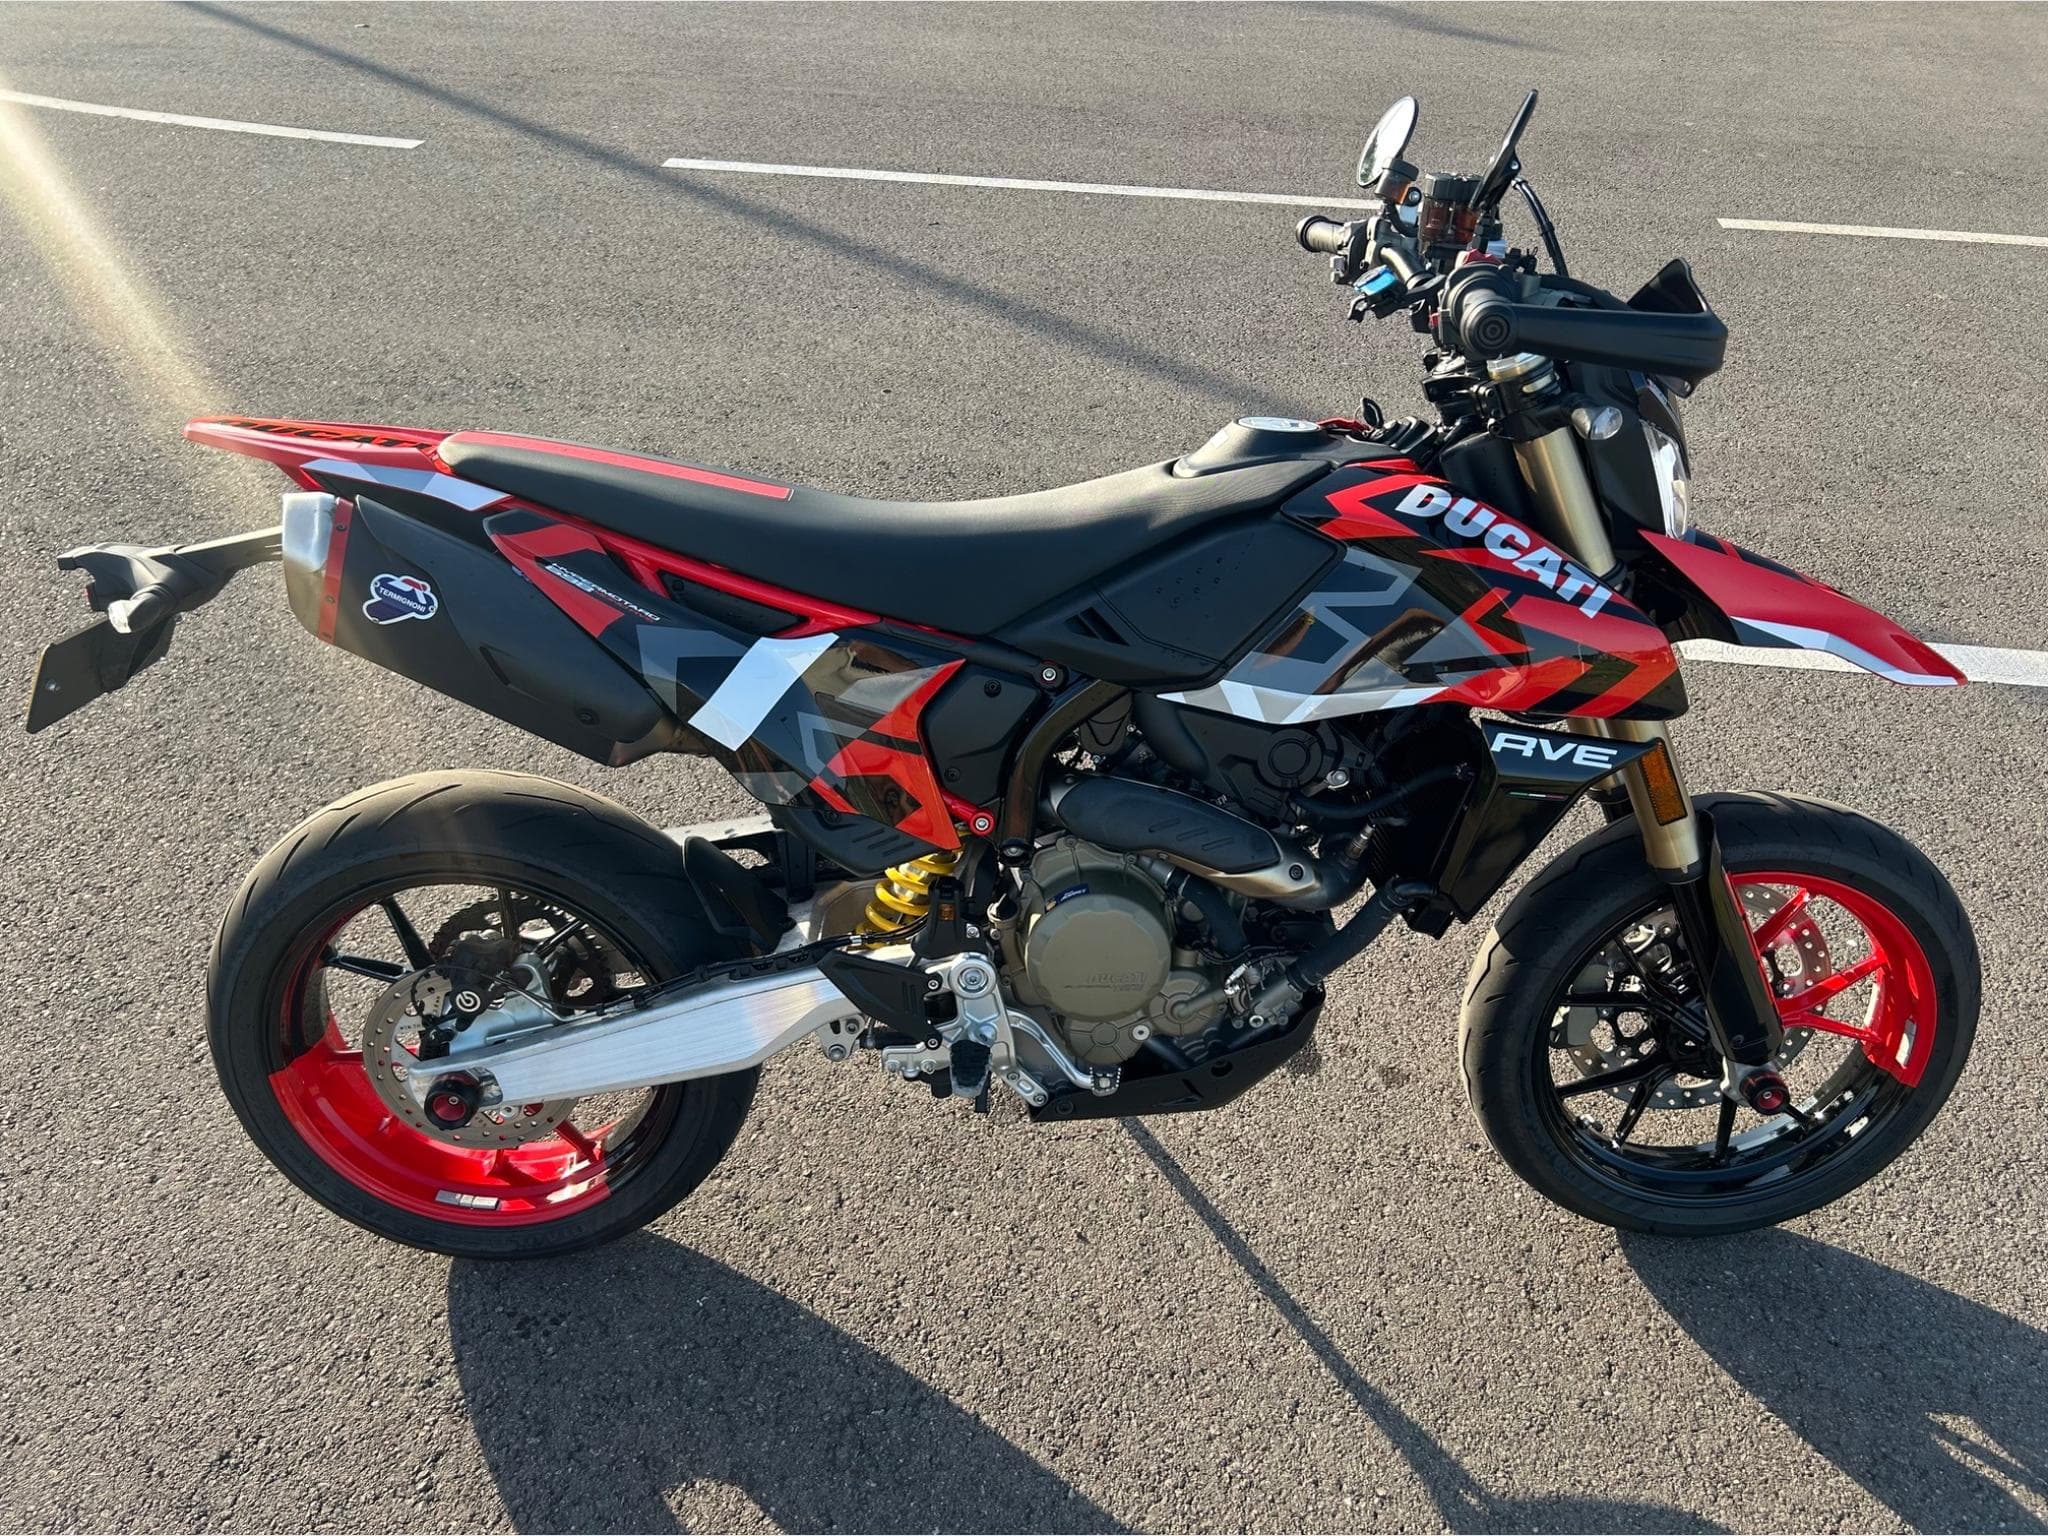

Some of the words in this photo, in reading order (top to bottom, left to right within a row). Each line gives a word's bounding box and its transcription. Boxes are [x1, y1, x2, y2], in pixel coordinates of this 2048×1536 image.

[214, 419, 433, 448] DUCATI
[1395, 484, 1613, 619] DUCATI
[379, 587, 427, 613] TERMIGNONI
[1490, 732, 1618, 769] RVE
